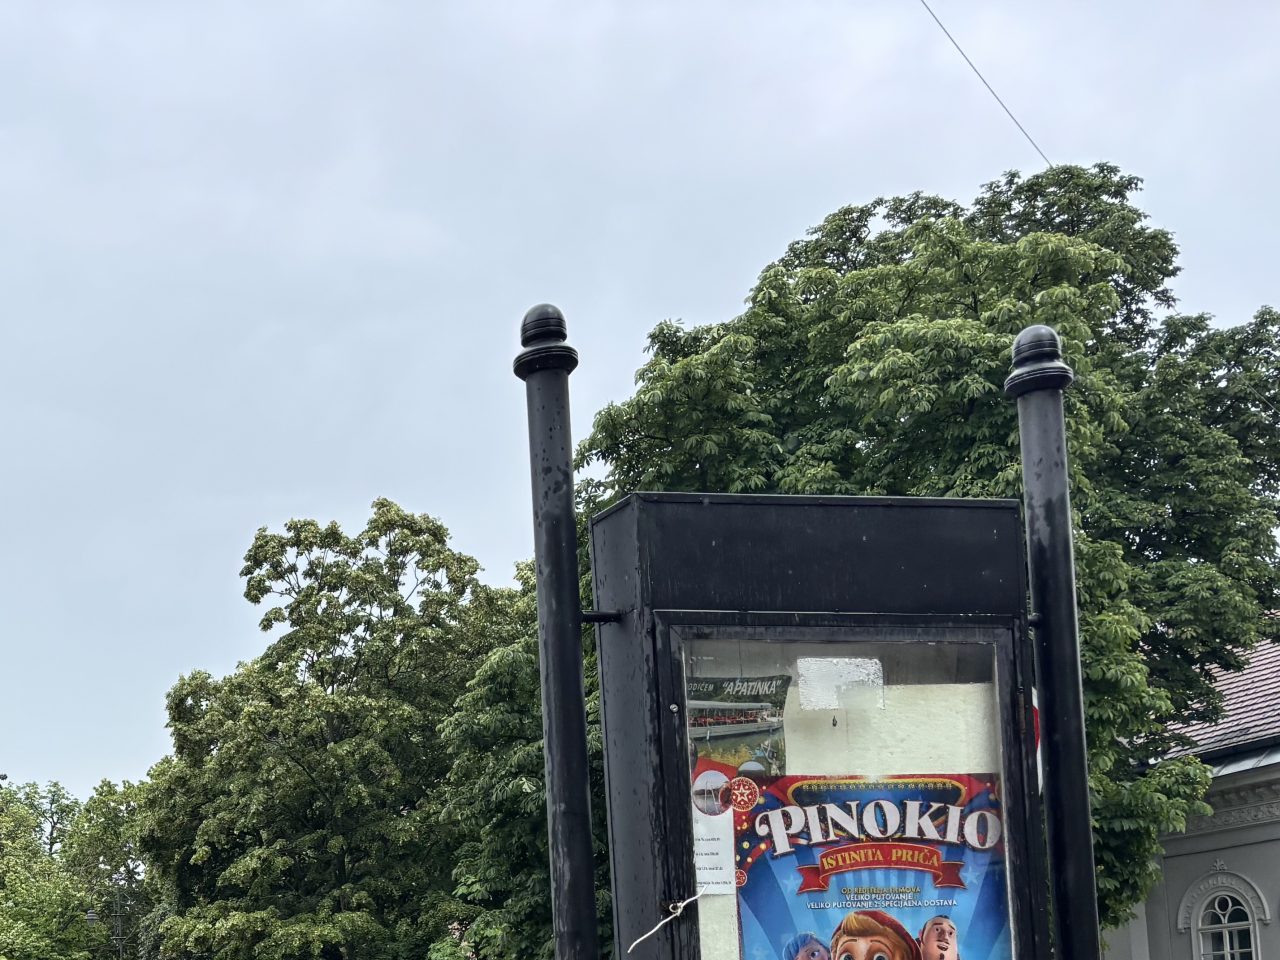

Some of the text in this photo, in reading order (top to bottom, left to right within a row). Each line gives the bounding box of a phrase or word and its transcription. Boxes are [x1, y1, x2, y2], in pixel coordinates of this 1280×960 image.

[754, 799, 1002, 857] PINOKIO
[822, 847, 940, 870] ISTINITA PRIČA
[833, 901, 872, 909] PUTOVANJE
